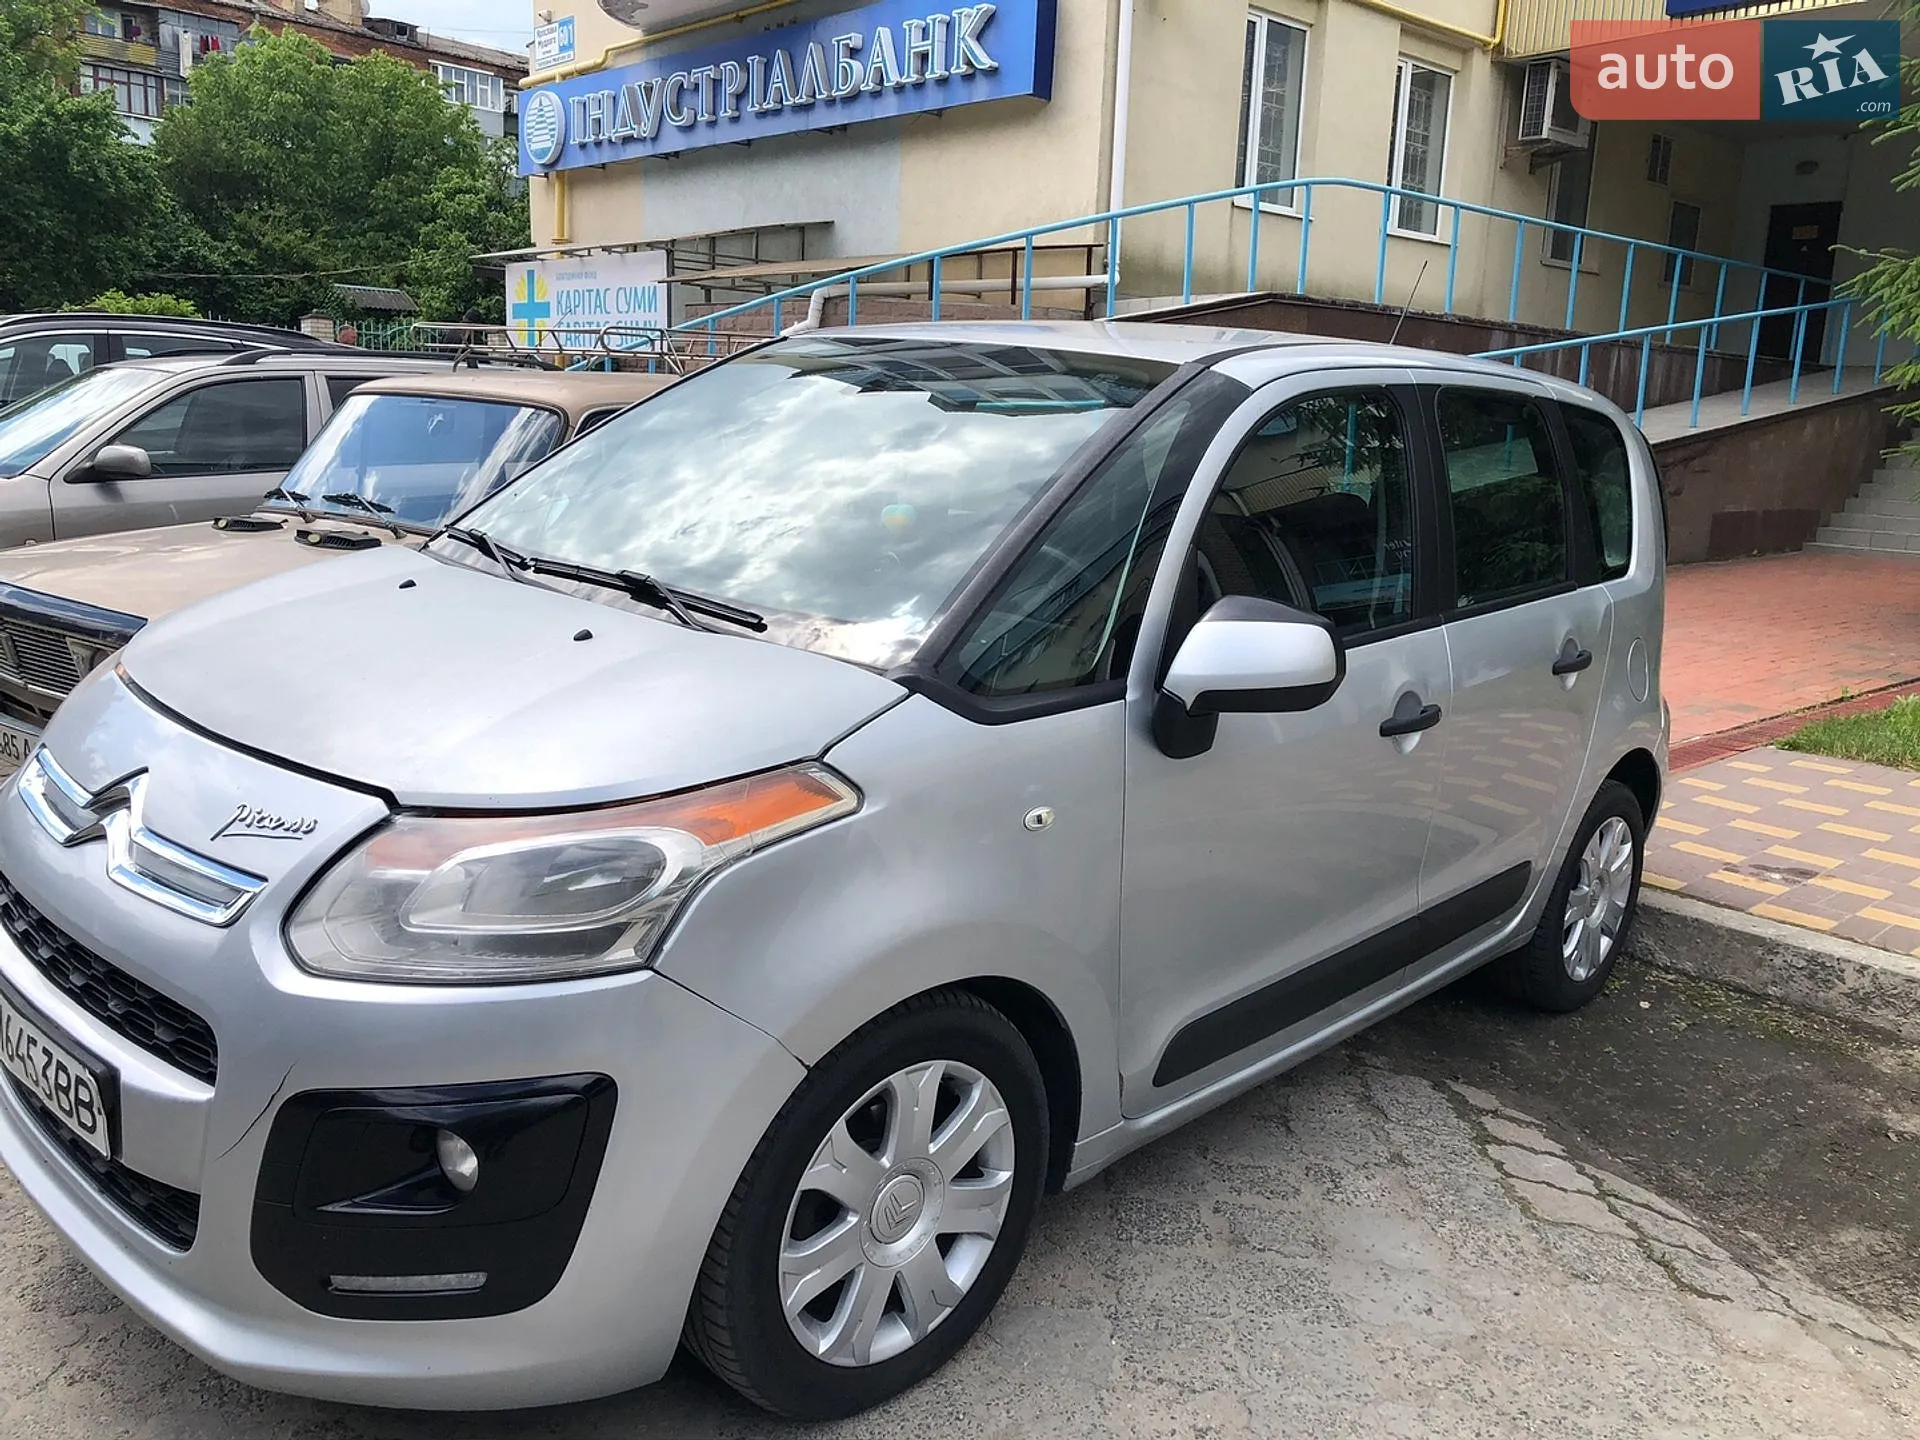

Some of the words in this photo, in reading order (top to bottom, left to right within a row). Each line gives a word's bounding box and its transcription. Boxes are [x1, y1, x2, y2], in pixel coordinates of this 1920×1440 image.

[569, 3, 999, 145] ІНДУСТРІАЛБАНК
[556, 287, 611, 316] КАРІТАС
[616, 286, 658, 314] СУМИ
[0, 1005, 97, 1135] 6453BB
